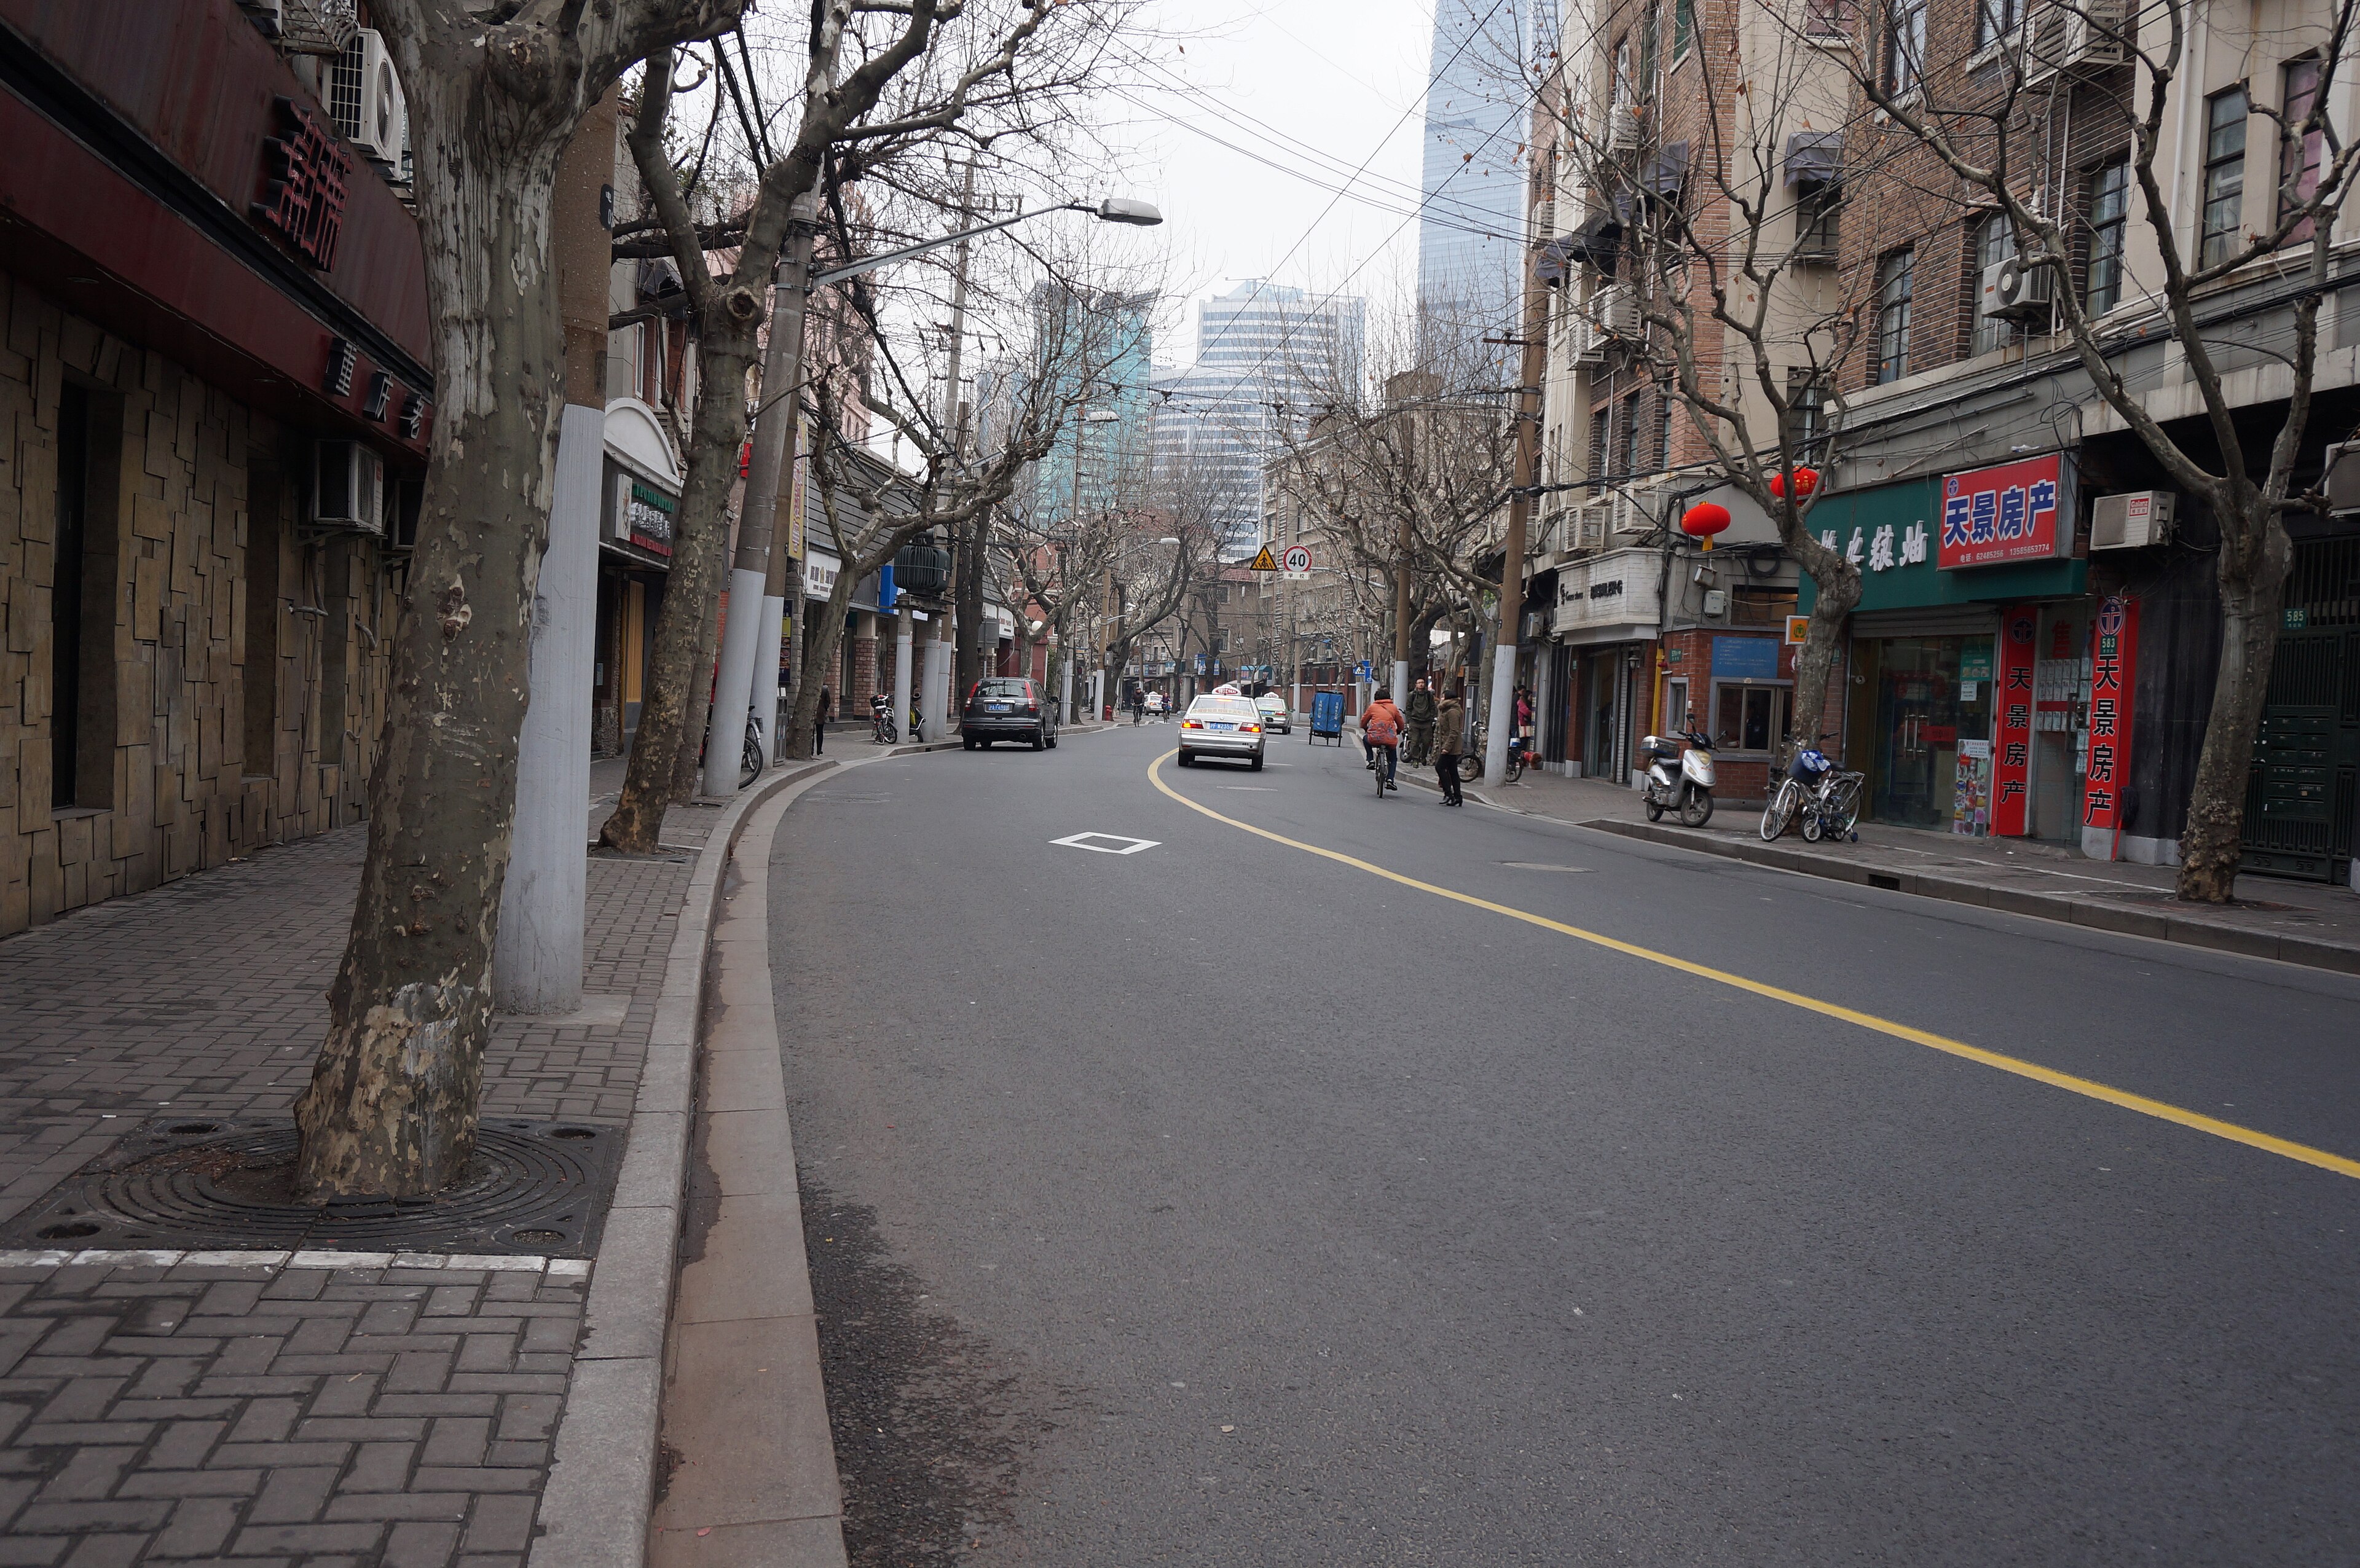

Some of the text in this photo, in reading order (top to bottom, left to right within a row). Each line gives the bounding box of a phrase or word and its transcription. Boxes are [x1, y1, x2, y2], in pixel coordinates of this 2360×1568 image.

[1943, 479, 2056, 549] 天景房产
[1289, 553, 1306, 566] 40
[1976, 550, 2004, 560] 62485256
[2286, 610, 2304, 622] 585
[2101, 637, 2115, 648] 583
[2000, 666, 2032, 804] 天景房产
[2085, 654, 2120, 825] 天景房产
